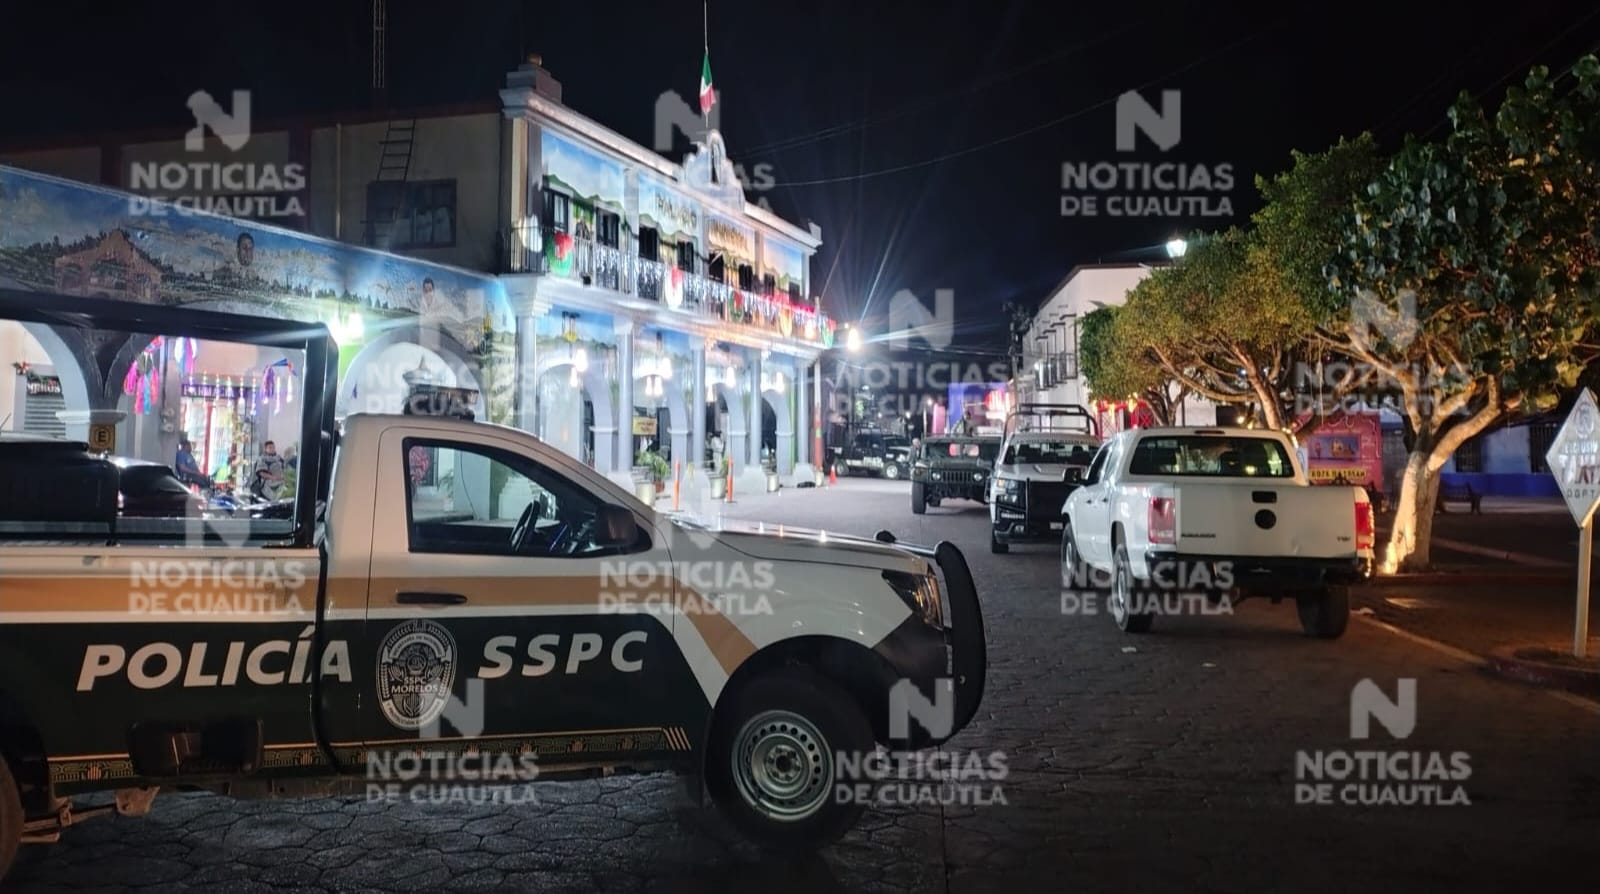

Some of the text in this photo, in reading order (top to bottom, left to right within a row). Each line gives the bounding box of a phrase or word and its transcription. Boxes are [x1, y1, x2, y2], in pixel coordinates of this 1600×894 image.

[76, 625, 352, 691] POLICÍA
[478, 632, 648, 678] SSPC
[391, 684, 439, 694] MORELOS
[403, 676, 427, 685] SSPC
